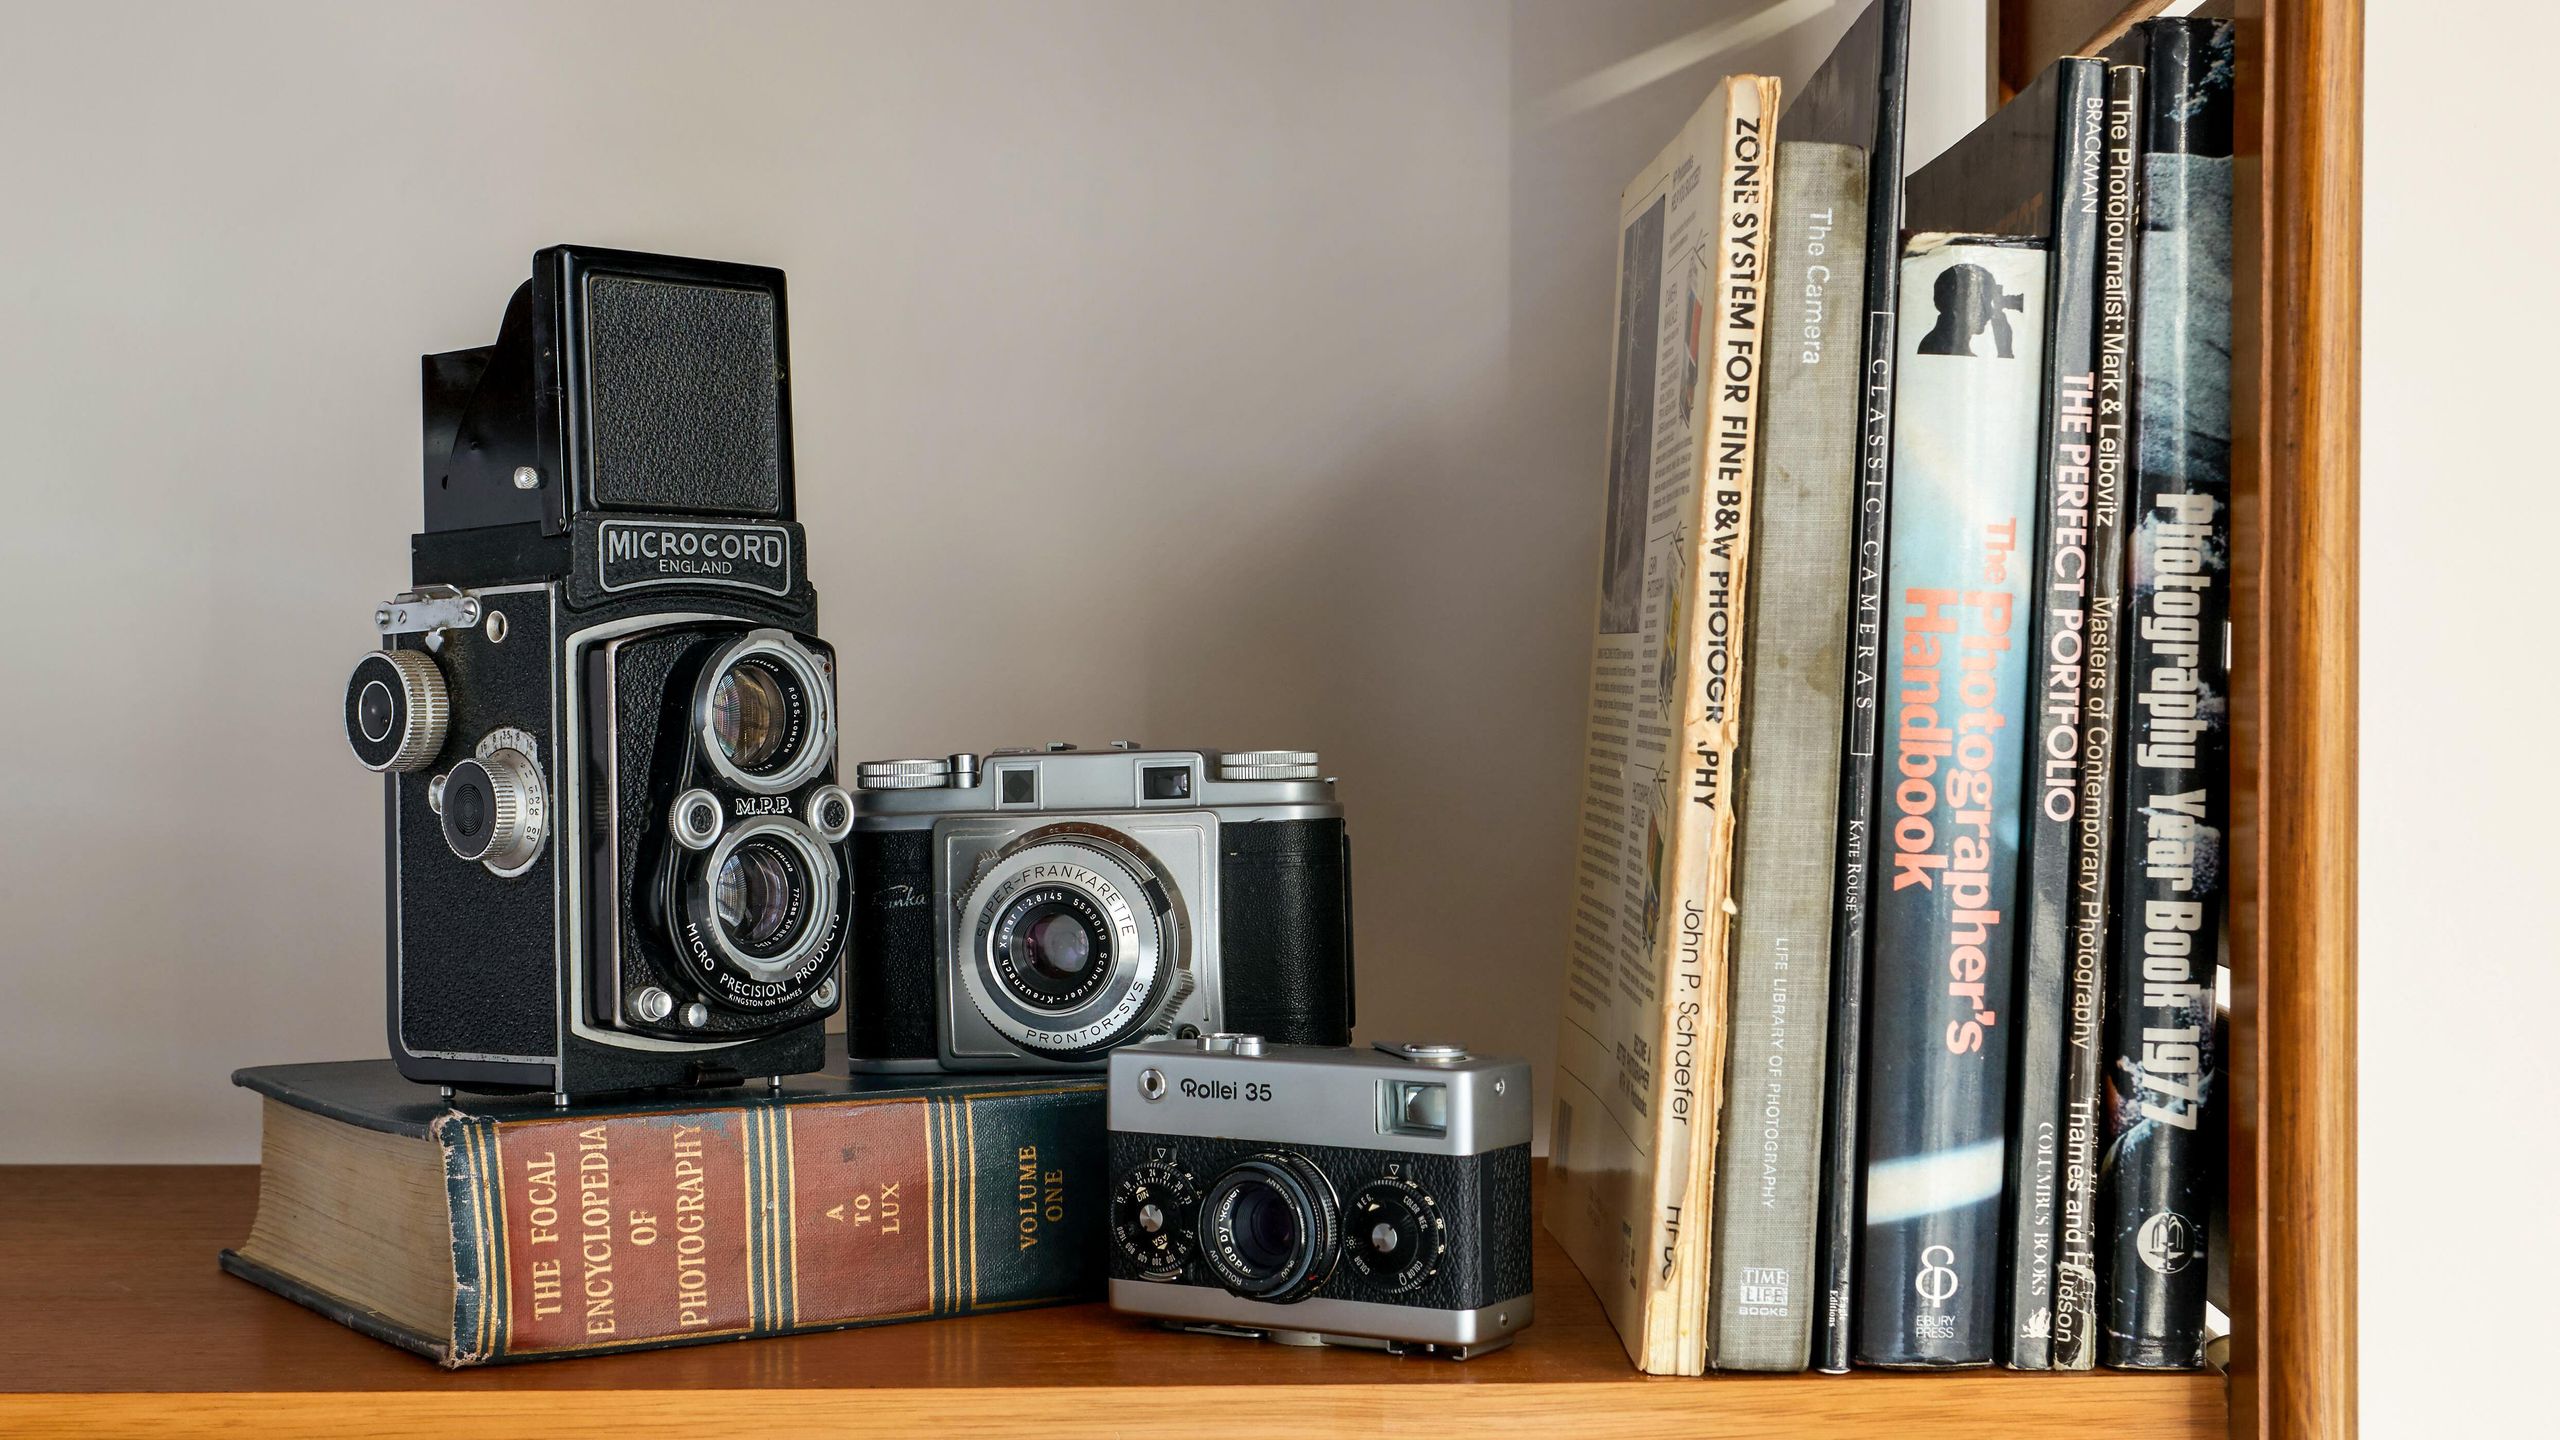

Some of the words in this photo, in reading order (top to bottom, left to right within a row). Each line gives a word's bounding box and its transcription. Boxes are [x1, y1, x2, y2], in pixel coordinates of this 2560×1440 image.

[2109, 94, 2133, 140] The
[1732, 117, 1762, 204] ZONE
[2080, 97, 2104, 213] BRACKMAN
[1807, 207, 1833, 256] The
[2103, 144, 2132, 330] Photojournalist:
[1728, 212, 1760, 330] SYSTEM
[1801, 265, 1831, 365] Camera
[1723, 340, 1754, 402] FOR
[2101, 332, 2125, 393] Mark
[2060, 371, 2095, 434] THE
[2100, 398, 2122, 415] &
[1717, 415, 1749, 481] FINE
[1864, 358, 1889, 514] CLASSIC
[2095, 425, 2122, 528] Leibovitz
[608, 530, 783, 568] MICROCORD
[1709, 490, 1742, 560] B&W
[1983, 517, 2017, 584] The
[2054, 443, 2091, 597] PERFECT
[659, 559, 733, 575] ENGLAND
[1855, 539, 1881, 710] CAMERAS
[2086, 597, 2114, 689] Masters
[2136, 493, 2214, 769] Photography
[1692, 571, 1730, 811] PHOTOGRPHY
[2043, 607, 2084, 823] PORTFOLIO
[2087, 698, 2105, 720] of
[1892, 588, 1959, 892] Handbook
[528, 785, 538, 793] 15
[528, 796, 541, 805] 20
[528, 808, 540, 816] 30
[735, 797, 792, 816] M.P.P.
[2078, 725, 2107, 894] Contemporary
[526, 826, 541, 836] 100
[1848, 820, 1864, 858] KATE
[1942, 590, 2014, 1055] Photographer's
[2146, 788, 2207, 892] Year
[976, 864, 1136, 939] SUPER-FRANKARETTE
[1845, 863, 1862, 912] ROUSE
[772, 919, 794, 941] XPRES
[999, 913, 1017, 948] Xenar
[1073, 898, 1107, 941] 5599019
[1680, 899, 1705, 965] John
[686, 922, 715, 971] MICRO
[720, 973, 787, 998] PRECISION
[1001, 952, 1108, 1004] Schneider-Kreuznach
[1679, 972, 1702, 993] P.
[1774, 938, 1789, 971] LIFE
[2069, 901, 2101, 1050] Photography
[2142, 900, 2203, 1008] Book
[728, 993, 763, 1007] KINGSTON
[765, 999, 776, 1007] ON
[777, 988, 803, 1004] THAMES
[1025, 980, 1145, 1045] PRONTOR-SVS
[1770, 978, 1787, 1050] LIBRARY
[1180, 1078, 1237, 1100] Rollei
[1245, 1082, 1273, 1102] 35
[1671, 1000, 1701, 1127] Schaefer
[1768, 1055, 1783, 1077] OF
[2141, 1025, 2201, 1131] 1977
[1148, 1168, 1156, 1177] 24
[1163, 1171, 1171, 1181] 27
[1762, 1083, 1781, 1209] PHOTOGRAPHY
[2034, 1122, 2054, 1226] COLUMBUS
[2067, 1097, 2093, 1192] Thames
[527, 1151, 560, 1245] FOCAL
[630, 1209, 658, 1246] OF
[673, 1124, 710, 1327] PHOTOGRAPHY
[825, 1203, 845, 1223] A
[854, 1193, 872, 1227] TO
[881, 1180, 900, 1236] LUX
[1018, 1144, 1039, 1252] VOLUME
[1044, 1169, 1063, 1224] ONE
[1136, 1190, 1150, 1203] DIN
[1403, 1195, 1421, 1214] COLOR
[2064, 1199, 2086, 1244] and
[579, 1124, 616, 1336] ENCYCLOPEDIA
[1151, 1233, 1168, 1247] ASA
[533, 1259, 562, 1322] THE
[1354, 1255, 1371, 1275] COLOR
[1406, 1260, 1423, 1279] COLOR
[1743, 1269, 1787, 1285] TIME
[1746, 1287, 1783, 1303] LIFE
[2031, 1232, 2049, 1296] BOOKS
[1739, 1306, 1788, 1317] BOOKS
[1916, 1315, 1956, 1327] EBURY
[2056, 1251, 2087, 1343] Hudson
[1915, 1327, 1955, 1339] PRESS
